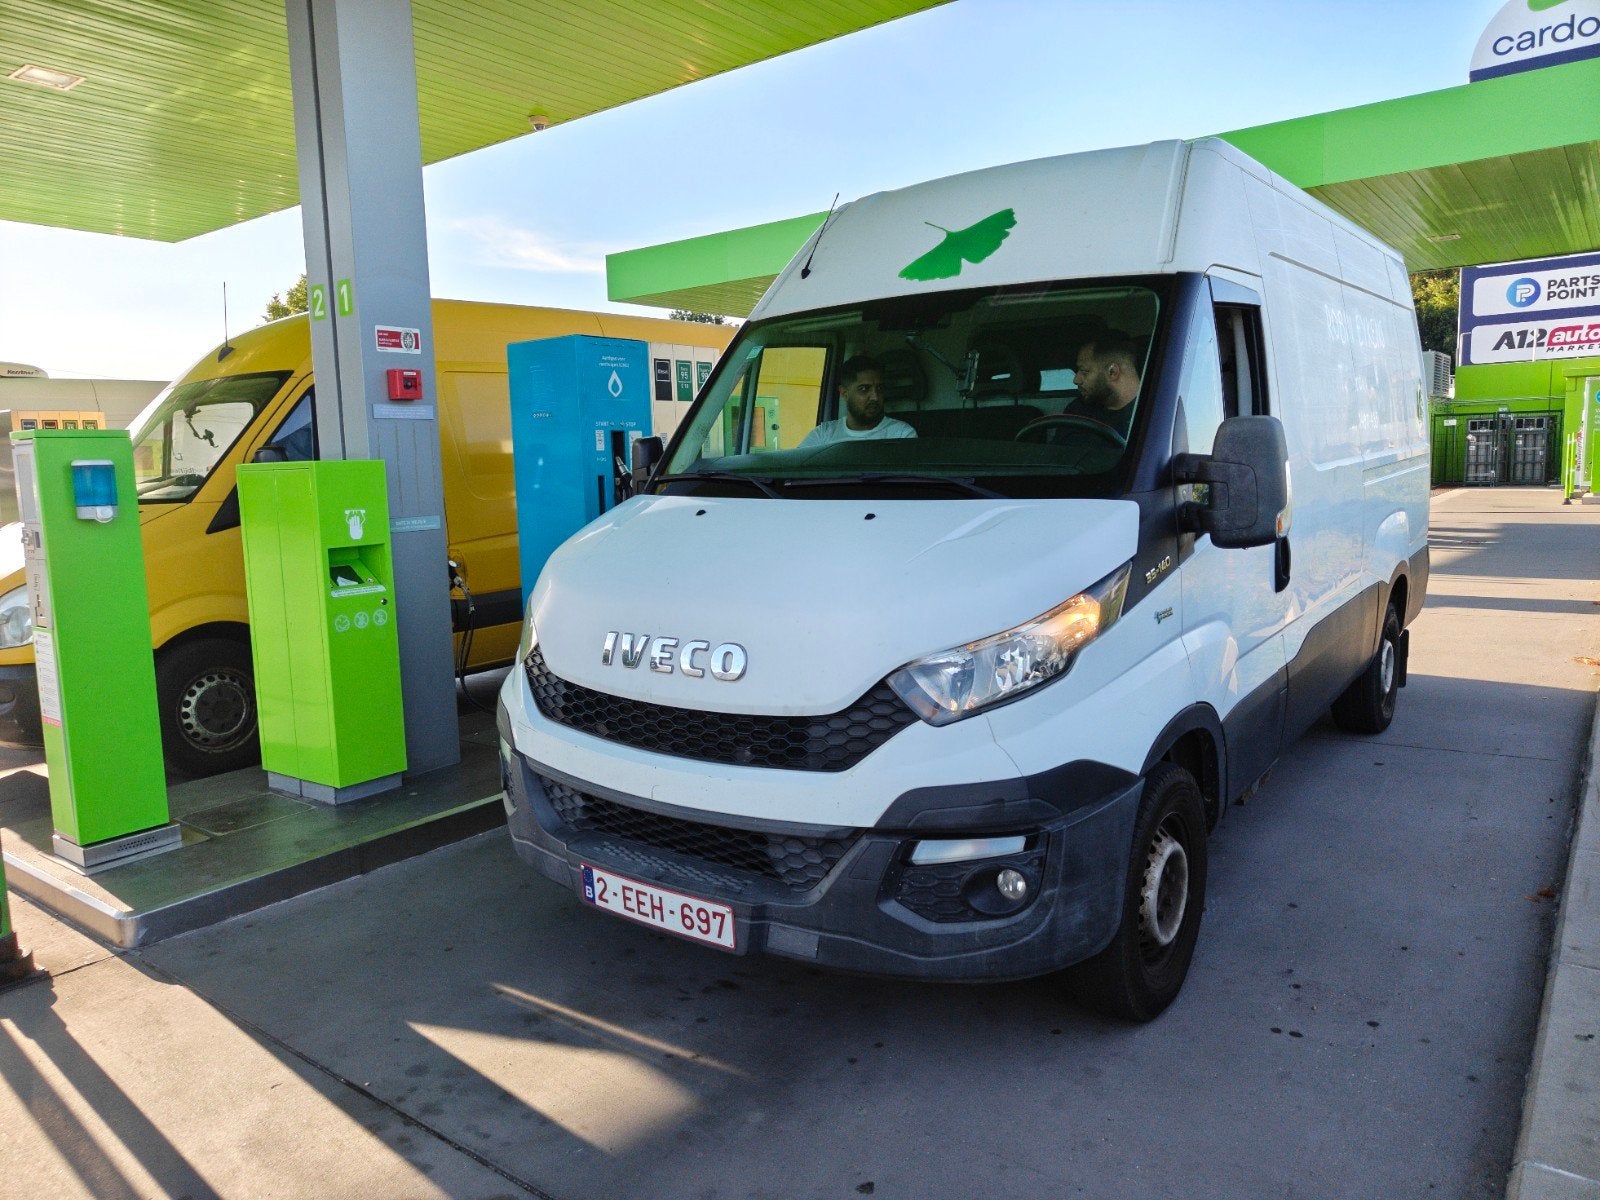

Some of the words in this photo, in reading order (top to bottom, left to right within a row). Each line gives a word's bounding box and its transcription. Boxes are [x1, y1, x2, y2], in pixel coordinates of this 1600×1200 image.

[1492, 13, 1600, 56] cardo
[1546, 286, 1599, 301] POINT
[1547, 275, 1600, 290] PARTS
[313, 288, 325, 317] 2
[340, 283, 349, 312] 1
[1492, 328, 1548, 351] A12
[1552, 324, 1600, 344] auto
[680, 371, 689, 380] 95
[601, 630, 749, 682] IVECO
[585, 885, 594, 899] B
[596, 876, 727, 940] 2-EEH-697
